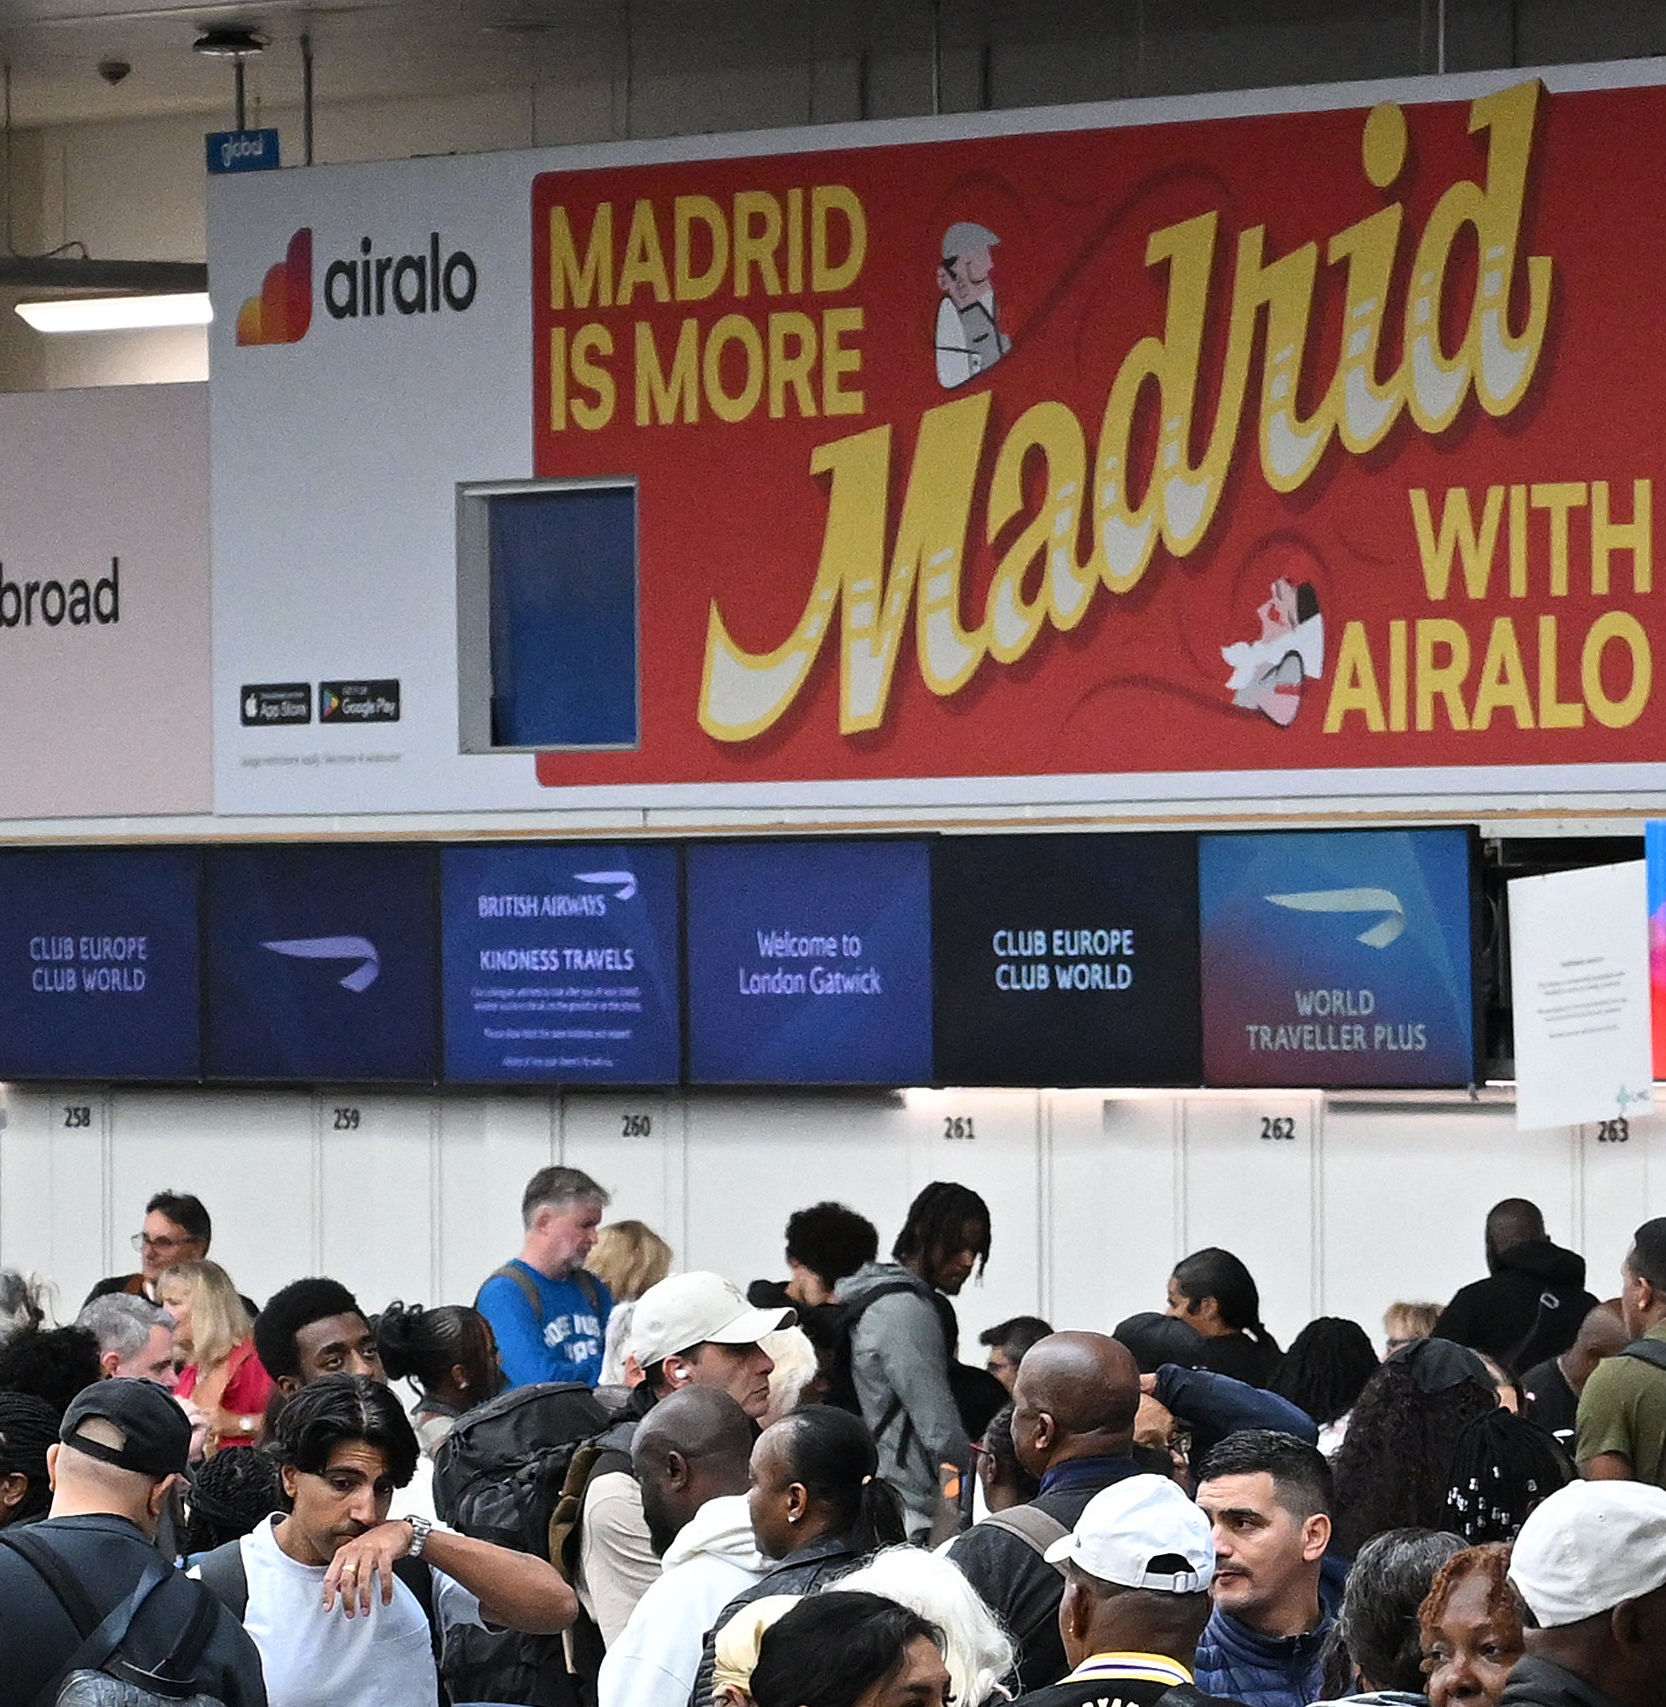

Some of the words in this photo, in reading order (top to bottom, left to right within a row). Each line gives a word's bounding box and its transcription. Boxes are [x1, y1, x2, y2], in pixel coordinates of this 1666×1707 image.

[550, 185, 867, 309] MADRID
[324, 232, 477, 320] airalo
[551, 323, 615, 432] IS
[635, 307, 865, 427] MORE
[698, 83, 1552, 743] Madrid
[1410, 478, 1652, 599] WITH
[1324, 613, 1652, 734] AIRALO
[341, 698, 375, 718] Google
[478, 895, 538, 918] BRITISH
[542, 895, 606, 917] AIRWAYS
[30, 936, 74, 960] CLUB
[80, 936, 148, 960] EUROPE
[758, 929, 835, 958] Welcome
[841, 929, 861, 958] to
[993, 929, 1046, 957] CLUB
[1053, 929, 1134, 957] EUROPE
[480, 950, 559, 971] KINDNESS
[563, 948, 634, 971] TRAVELS
[33, 968, 76, 992] CLUB
[81, 968, 145, 992] WORLD
[740, 968, 804, 995] London
[810, 968, 881, 995] Gatwick
[996, 964, 1050, 992] CLUB
[1055, 964, 1132, 992] WORLD
[1296, 991, 1374, 1017] WORLD
[1247, 1024, 1366, 1051] TRAVELLER
[1373, 1024, 1426, 1051] PLUS
[65, 1107, 90, 1127] 258
[333, 1109, 359, 1130] 259
[622, 1115, 651, 1137] 260
[943, 1117, 974, 1140] 261
[1261, 1117, 1294, 1141] 262
[1598, 1118, 1629, 1143] 263
